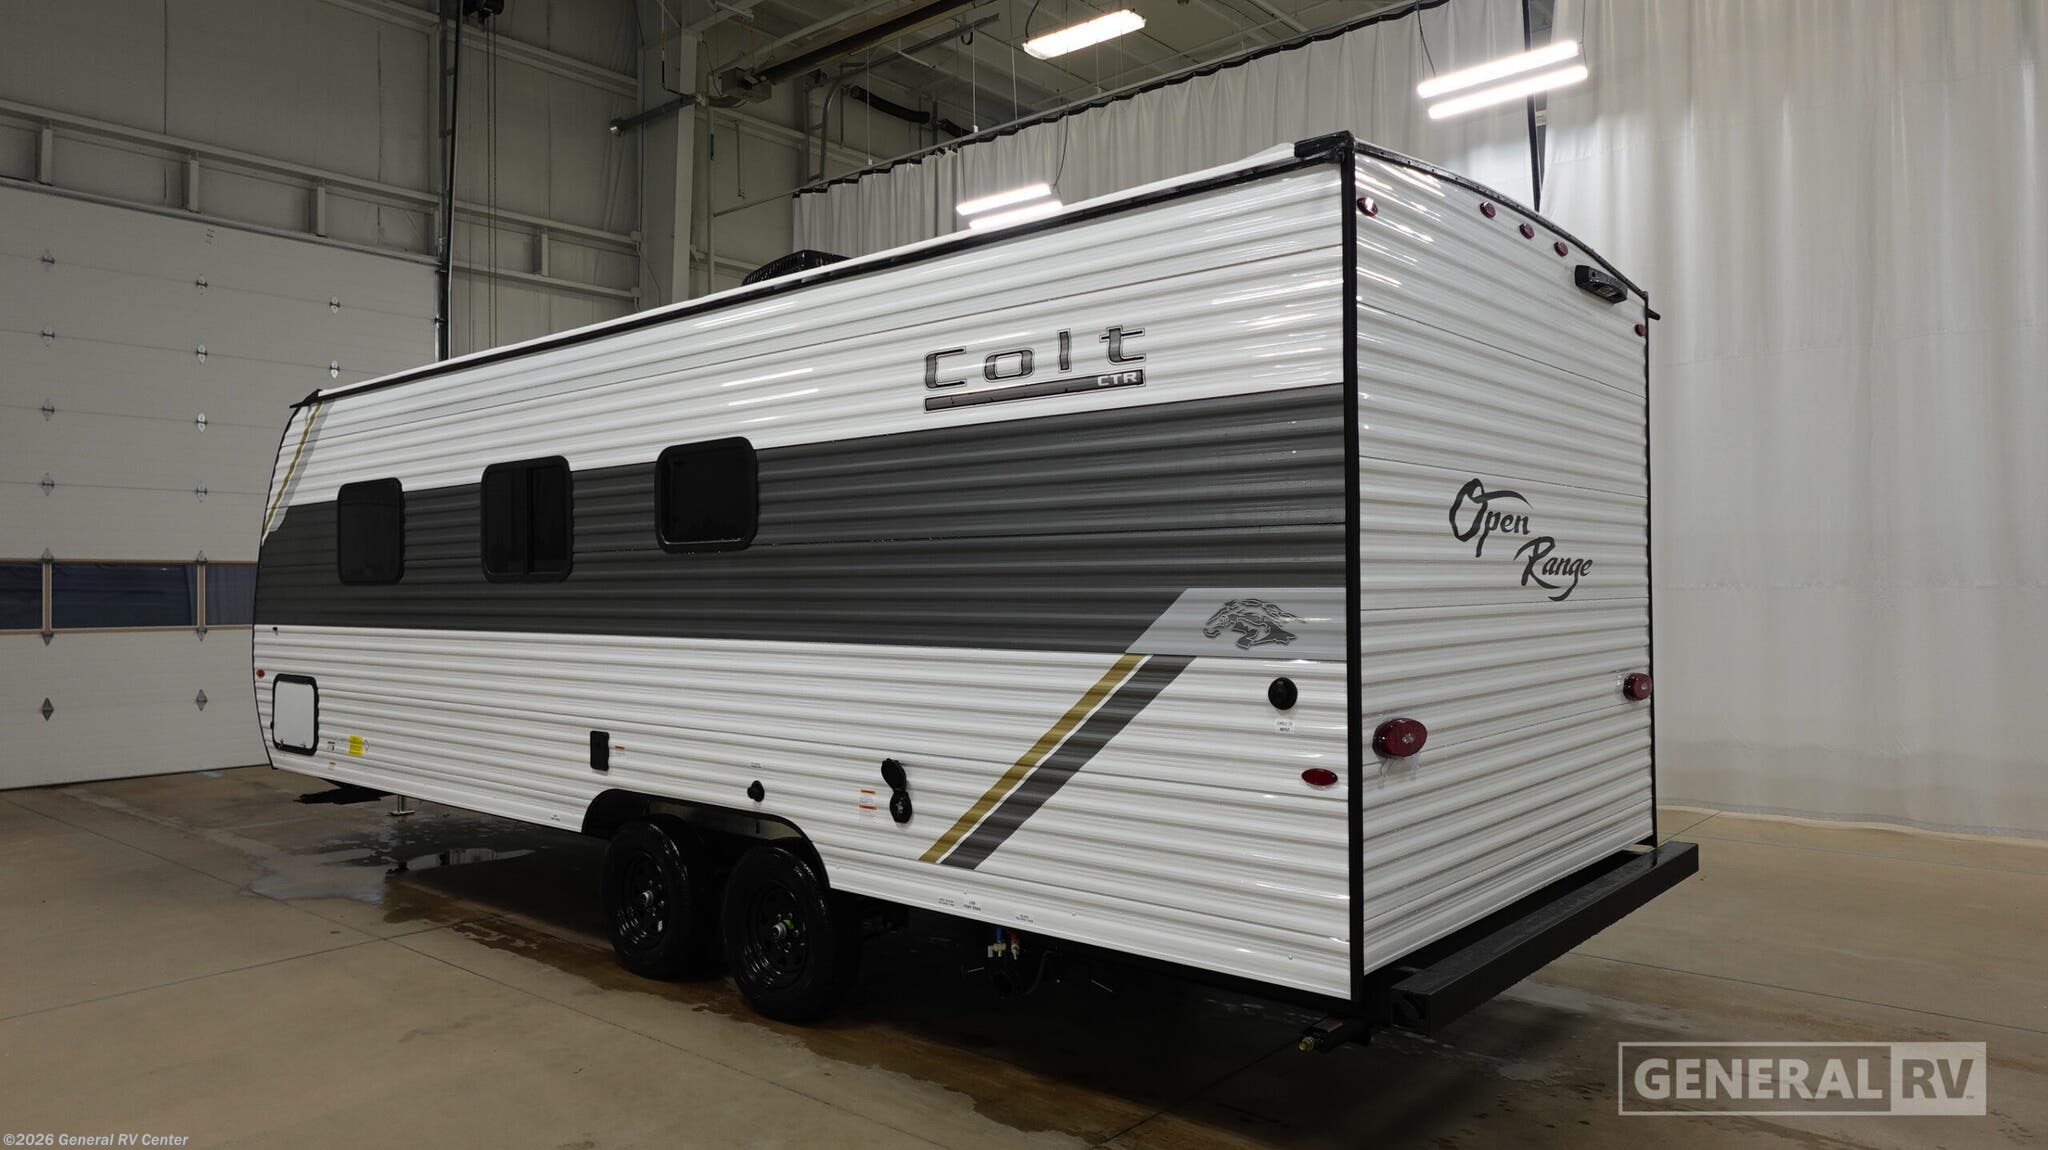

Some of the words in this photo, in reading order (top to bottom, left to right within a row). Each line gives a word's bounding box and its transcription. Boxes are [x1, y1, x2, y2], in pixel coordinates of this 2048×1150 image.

[924, 325, 1146, 391] Colt
[1097, 371, 1138, 387] CTR
[1449, 478, 1534, 558] Open
[1513, 536, 1593, 602] Range
